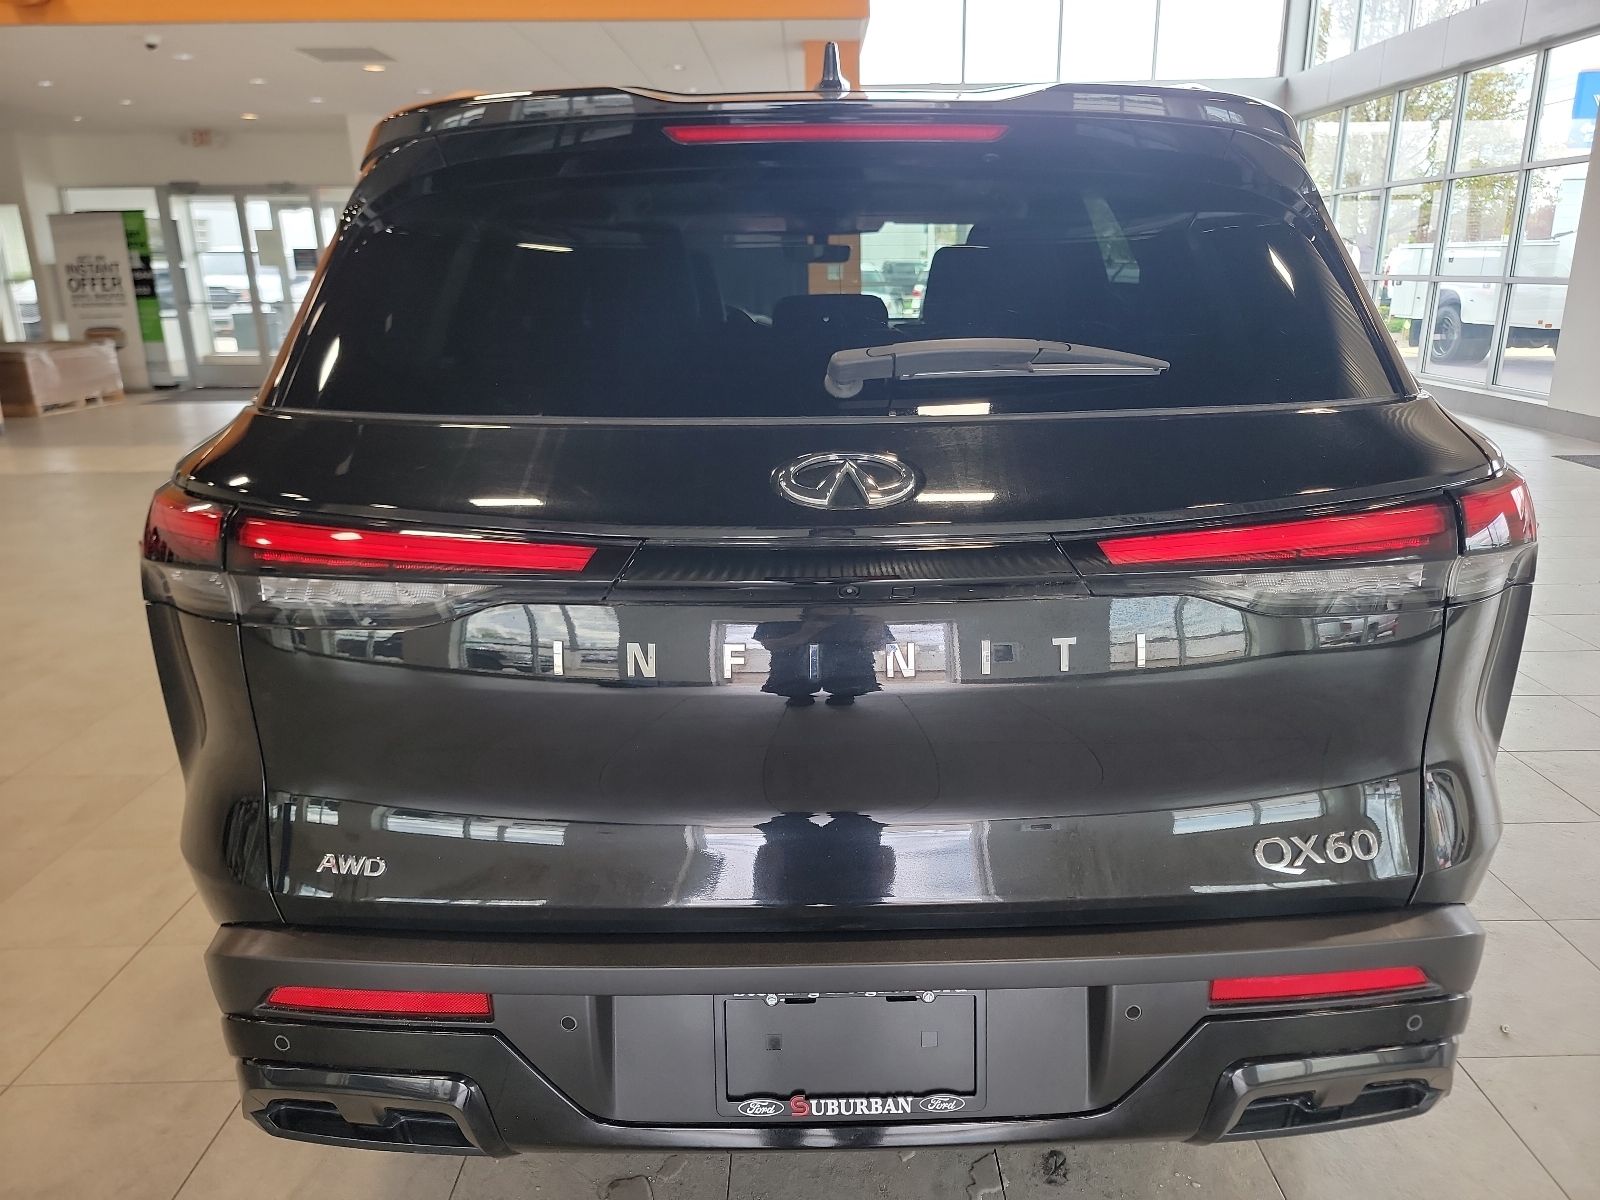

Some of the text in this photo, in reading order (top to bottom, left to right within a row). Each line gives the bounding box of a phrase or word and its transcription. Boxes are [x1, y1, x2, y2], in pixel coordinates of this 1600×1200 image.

[67, 277, 123, 293] OFFER
[553, 633, 1146, 679] INFINITI
[1254, 829, 1379, 875] QX60
[316, 853, 386, 877] AWD
[746, 1095, 957, 1117] Ford SUBURBAN Ford
